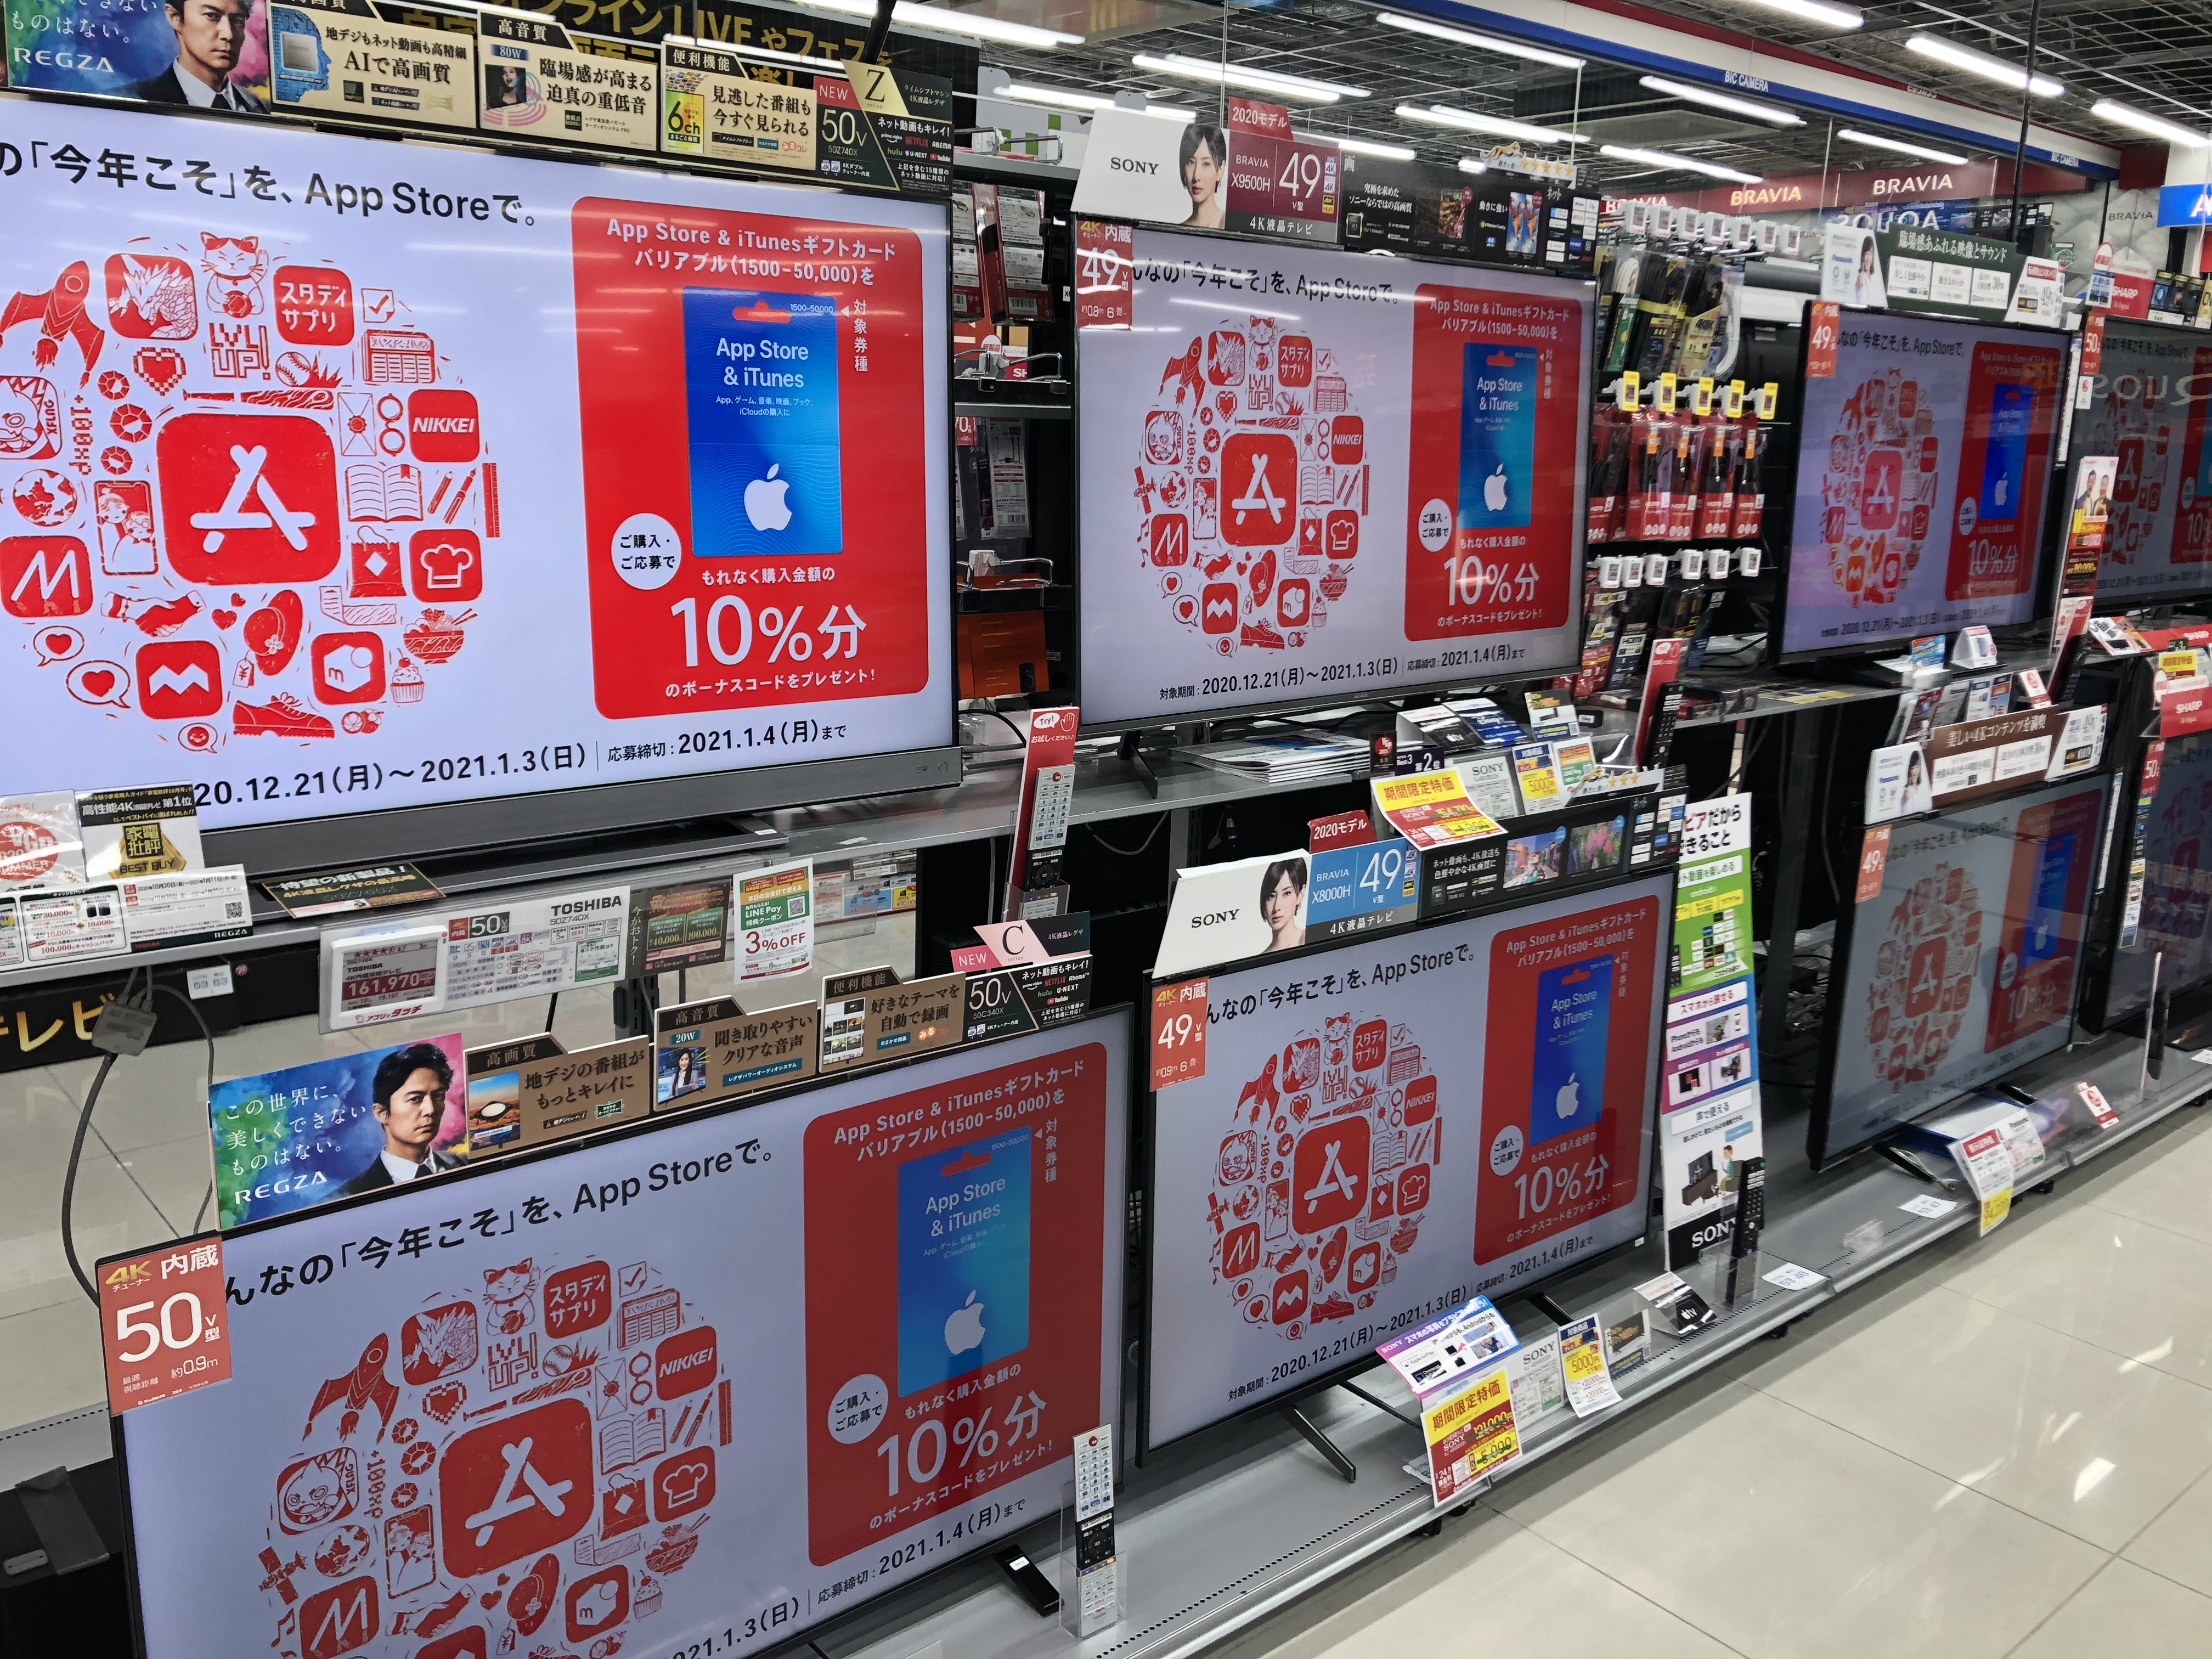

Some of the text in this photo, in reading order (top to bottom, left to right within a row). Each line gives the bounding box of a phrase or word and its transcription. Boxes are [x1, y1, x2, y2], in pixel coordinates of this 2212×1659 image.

[12, 10, 130, 43] ものはない。
[498, 19, 547, 42] 高音質
[325, 26, 467, 59] 地デジもネット動画も高精細
[499, 46, 522, 59] 80W
[13, 47, 114, 73] REGZA
[343, 50, 451, 84] AIで高画質
[673, 49, 730, 71] 便利機能
[539, 57, 652, 92] 臨場感が高まる
[865, 69, 885, 103] Z
[1725, 71, 1769, 93] BIC CAMERA
[546, 83, 646, 115] 迫真の重低音
[712, 86, 810, 115] 見逃した番組も
[819, 84, 848, 100] NEW
[668, 100, 700, 135] 6ch
[713, 109, 809, 136] 今すぐ見られる
[878, 117, 950, 137] ネット動画もキレイ!
[1232, 106, 1287, 129] 2020モデル
[828, 145, 858, 156] 50Z740X
[887, 147, 902, 156] hulu
[905, 137, 928, 148] NETFLIX
[932, 141, 951, 150] ABEMA
[1110, 156, 1159, 176] SONY
[1235, 154, 1268, 168] BRAVIA
[1231, 173, 1270, 192] X9500H
[1279, 151, 1320, 199] 49
[1872, 173, 1953, 195] BRAVIA
[304, 172, 383, 217] App
[1730, 185, 1802, 207] BRAVIA
[1250, 216, 1313, 235] 4K液晶テレビ
[2109, 211, 2153, 221] BRAVIA
[607, 218, 648, 244] App
[656, 223, 710, 244] Store
[1104, 224, 1131, 243] 内蔵
[1082, 247, 1120, 289] 49
[281, 281, 347, 309] スタディ
[1296, 274, 1330, 301] App
[2112, 285, 2138, 298] SHARP
[281, 308, 336, 334] サプリ
[1812, 325, 1831, 349] 49
[716, 337, 809, 362] App Store
[744, 366, 804, 389] iTunes
[413, 416, 475, 435] NIKKEI
[1333, 434, 1362, 445] NIKKEI
[1460, 535, 1526, 549] もれなく購入金額の
[620, 555, 676, 570] ご応募で
[702, 566, 835, 586] もれなく購入金額の
[1444, 555, 1540, 606] 10%分
[670, 595, 867, 668] 10%分
[665, 668, 876, 698] のボーナスコードをプレゼント!
[2176, 700, 2202, 714] SHARP
[1472, 763, 1504, 776] SONY
[1383, 775, 1456, 800] 期間限定特価
[1402, 808, 1425, 820] SONY
[1313, 817, 1368, 840] 2020モデル
[120, 860, 174, 874] BEST BUY
[1359, 848, 1402, 893] 49
[1863, 849, 1880, 874] 49
[1316, 868, 1350, 882] BRAVIA
[551, 895, 622, 916] TOSHIBA
[1311, 885, 1351, 905] X8000H
[550, 913, 589, 925] 50Z740X
[745, 905, 781, 918] LINE Pay
[1191, 909, 1240, 929] SONY
[1330, 910, 1393, 935] 4K液晶テレビ
[214, 929, 247, 939] REGZA
[1002, 926, 1024, 956] C
[347, 963, 383, 973] TOSHIBA
[958, 951, 987, 967] NEW
[1022, 960, 1089, 981] ネット動画もキレイ!
[348, 973, 419, 996] 161,970
[833, 972, 885, 995] 便利機能
[1045, 975, 1066, 988] NETFLIX
[1372, 962, 1406, 985] App
[871, 984, 960, 1015] 好きなテーマを
[1037, 989, 1052, 997] hulu
[1057, 984, 1079, 995] U-NEXT
[1180, 983, 1207, 1002] 内蔵
[675, 1005, 720, 1025] 高音質
[880, 1005, 949, 1032] 自動で録画
[973, 1007, 1004, 1019] 50C340X
[675, 1031, 696, 1044] 20W
[714, 1014, 813, 1048] 聞き取りやすい
[1158, 1014, 1193, 1049] 49
[486, 1045, 536, 1068] 高画質
[723, 1034, 804, 1065] クリアな音声
[524, 1049, 644, 1091] 地デジの番組が
[225, 1084, 339, 1120] この世界に、
[537, 1076, 633, 1109] もっとキレイに
[1406, 1092, 1435, 1109] NIKKEI
[227, 1105, 366, 1150] 美しくできない
[834, 1122, 870, 1145] App
[876, 1110, 923, 1132] Store
[232, 1142, 342, 1176] ものはない。
[234, 1171, 329, 1205] REGZA
[572, 1176, 641, 1214] App
[926, 1176, 1006, 1215] App Store
[948, 1203, 1001, 1233] iTunes
[105, 1260, 153, 1285] 4K
[161, 1244, 219, 1280] 内蔵
[112, 1278, 151, 1293] チューナー
[549, 1274, 606, 1305] スタディ
[550, 1298, 596, 1328] サプリ
[116, 1291, 202, 1363] 50
[1381, 1339, 1403, 1354] SONY
[1523, 1342, 1556, 1365] SONY
[659, 1347, 713, 1378] NIKKEI
[905, 1363, 1020, 1420] もれなく購入金額の
[1432, 1379, 1501, 1431] 期間限定特価
[836, 1404, 883, 1432] ご応募で
[877, 1390, 1046, 1497] 10%分
[1443, 1434, 1465, 1452] SONY
[869, 1440, 1052, 1530] のボーナスコードをプレゼント!
